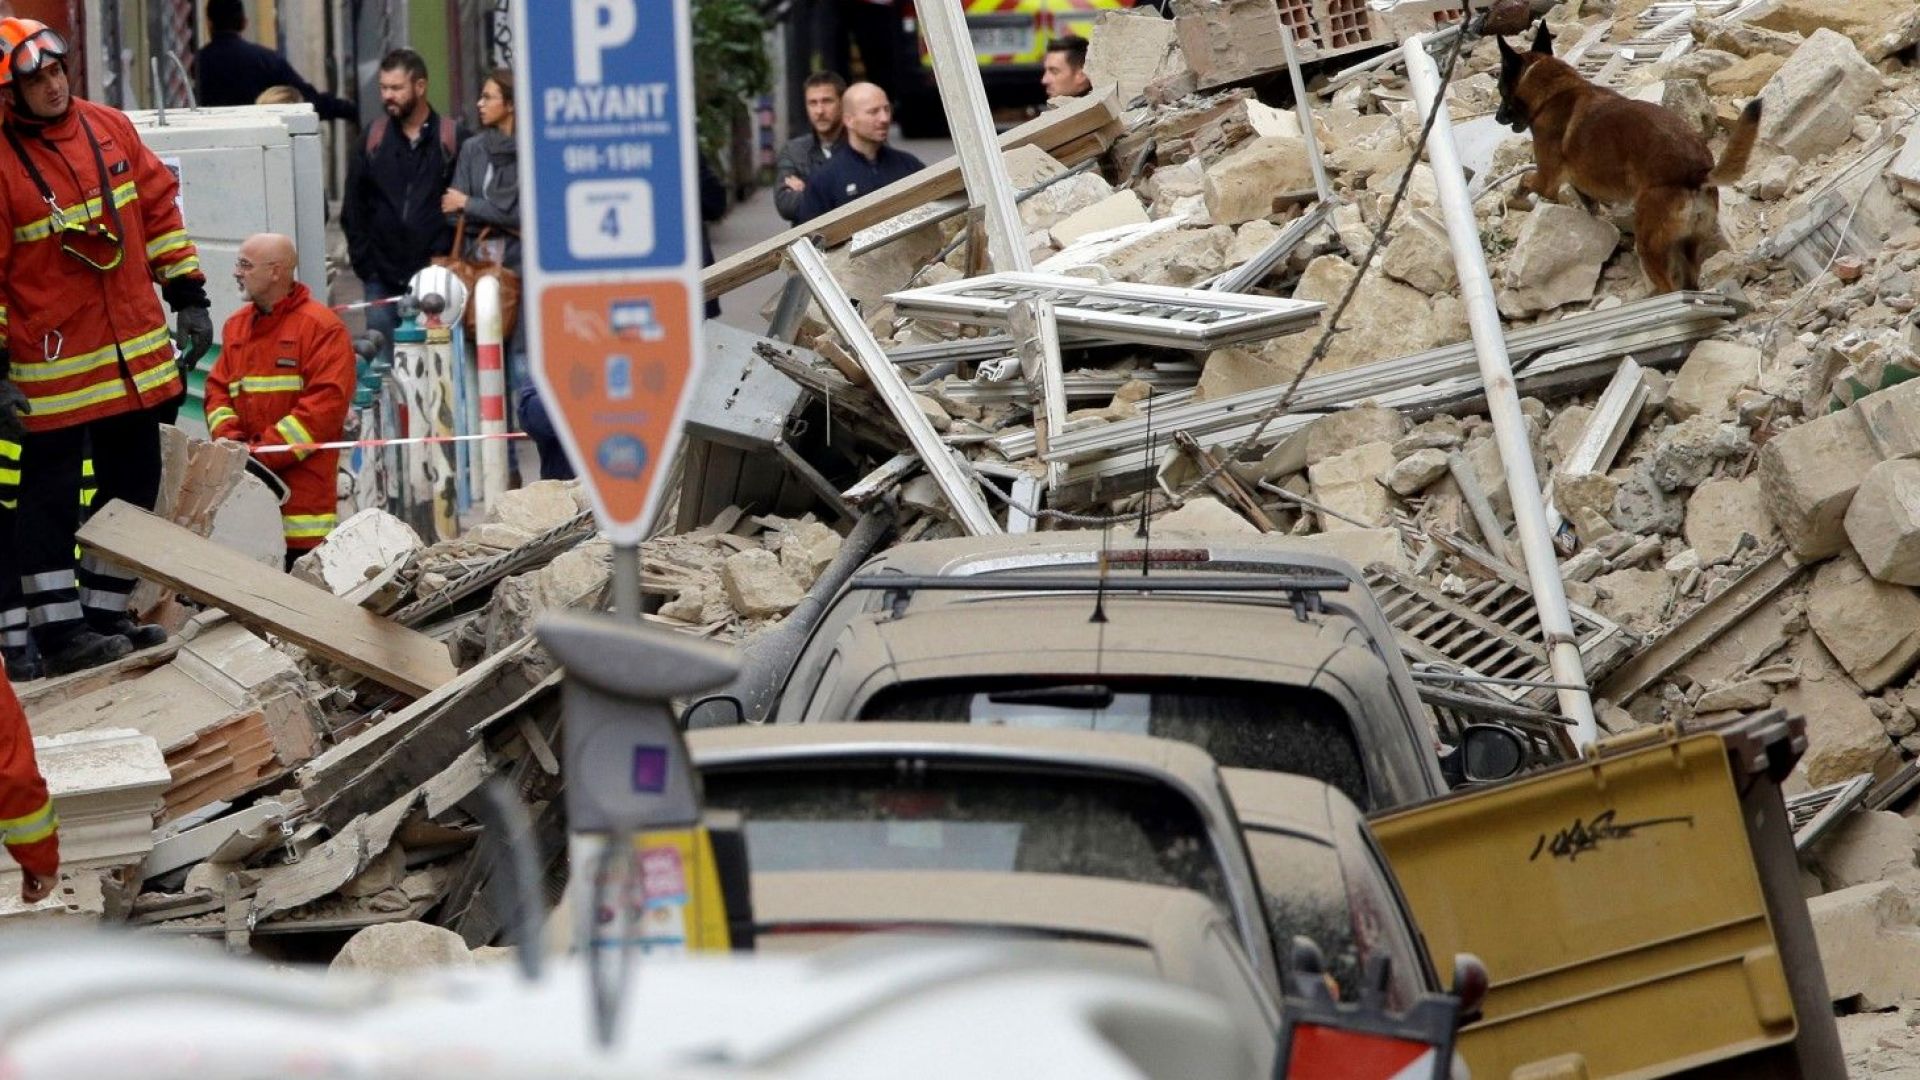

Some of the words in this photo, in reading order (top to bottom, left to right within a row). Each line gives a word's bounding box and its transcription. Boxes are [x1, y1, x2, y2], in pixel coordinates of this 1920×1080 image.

[571, 0, 638, 85] P
[544, 83, 668, 121] PAYANT
[563, 142, 653, 174] 9H-19H
[599, 206, 620, 239] 4
